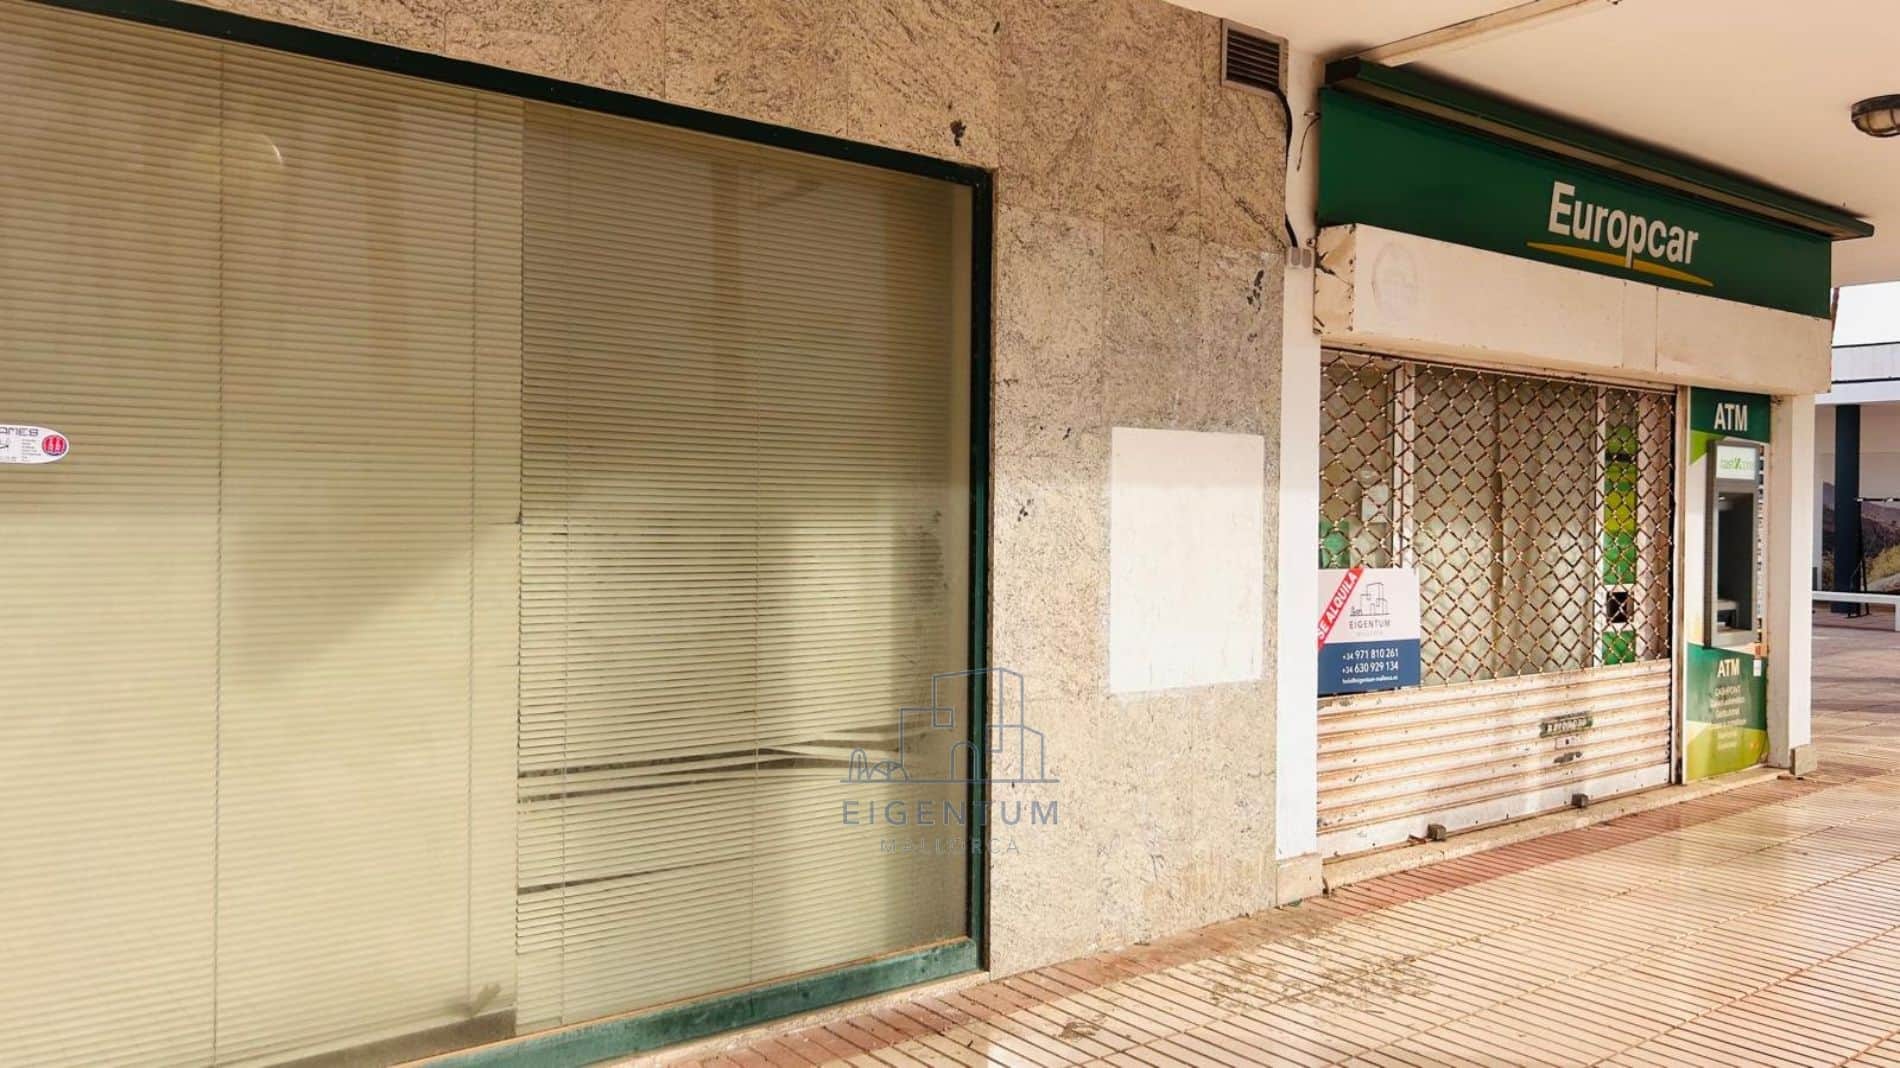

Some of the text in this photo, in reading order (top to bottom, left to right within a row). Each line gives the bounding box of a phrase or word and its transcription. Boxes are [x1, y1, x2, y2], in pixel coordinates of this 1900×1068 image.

[1548, 181, 1699, 268] Europcar
[1713, 402, 1748, 431] ATM
[1318, 572, 1358, 639] SE ALQUILA
[1349, 618, 1391, 629] EIGENTUM
[1343, 647, 1399, 660] +34 971 810 261
[1343, 660, 1399, 674] +34 630 929 134
[1717, 658, 1740, 678] ATM
